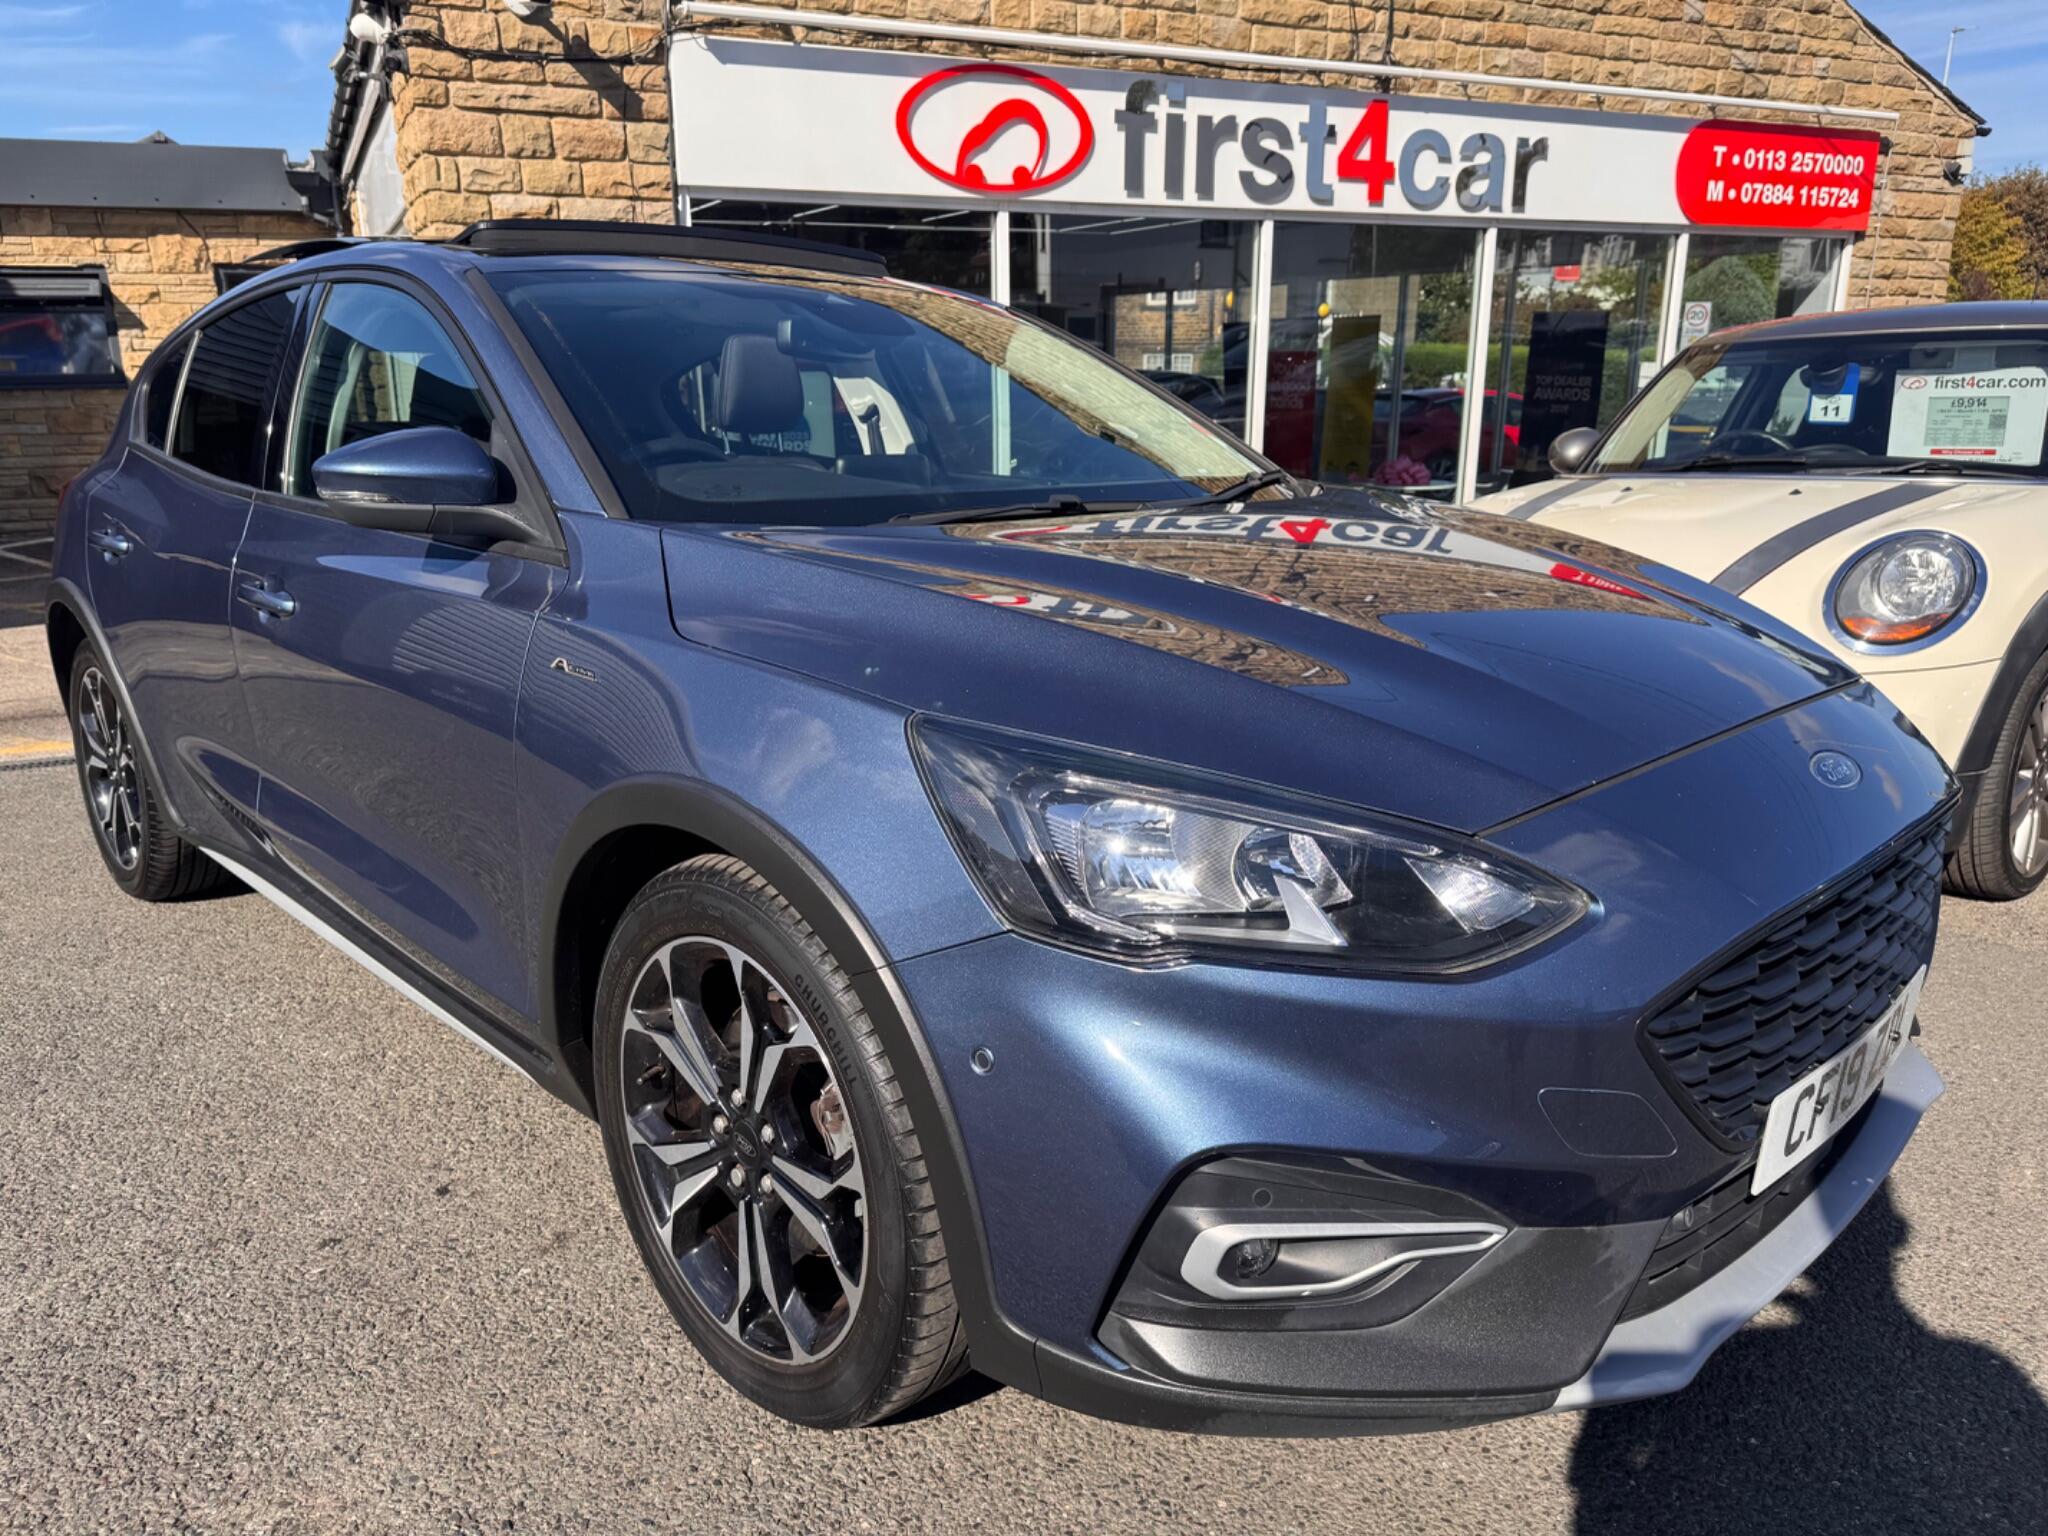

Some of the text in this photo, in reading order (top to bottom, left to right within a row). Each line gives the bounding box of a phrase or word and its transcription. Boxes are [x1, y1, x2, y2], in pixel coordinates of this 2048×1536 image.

[1114, 79, 1549, 213] first4car
[1713, 146, 1864, 176] T 0113 2570000
[1706, 180, 1860, 208] M 07884 115724
[1533, 387, 1592, 401] AWARDS
[1934, 375, 2047, 390] first4car.com
[1820, 405, 1842, 417] 11
[795, 973, 856, 1088] CHURCHILL
